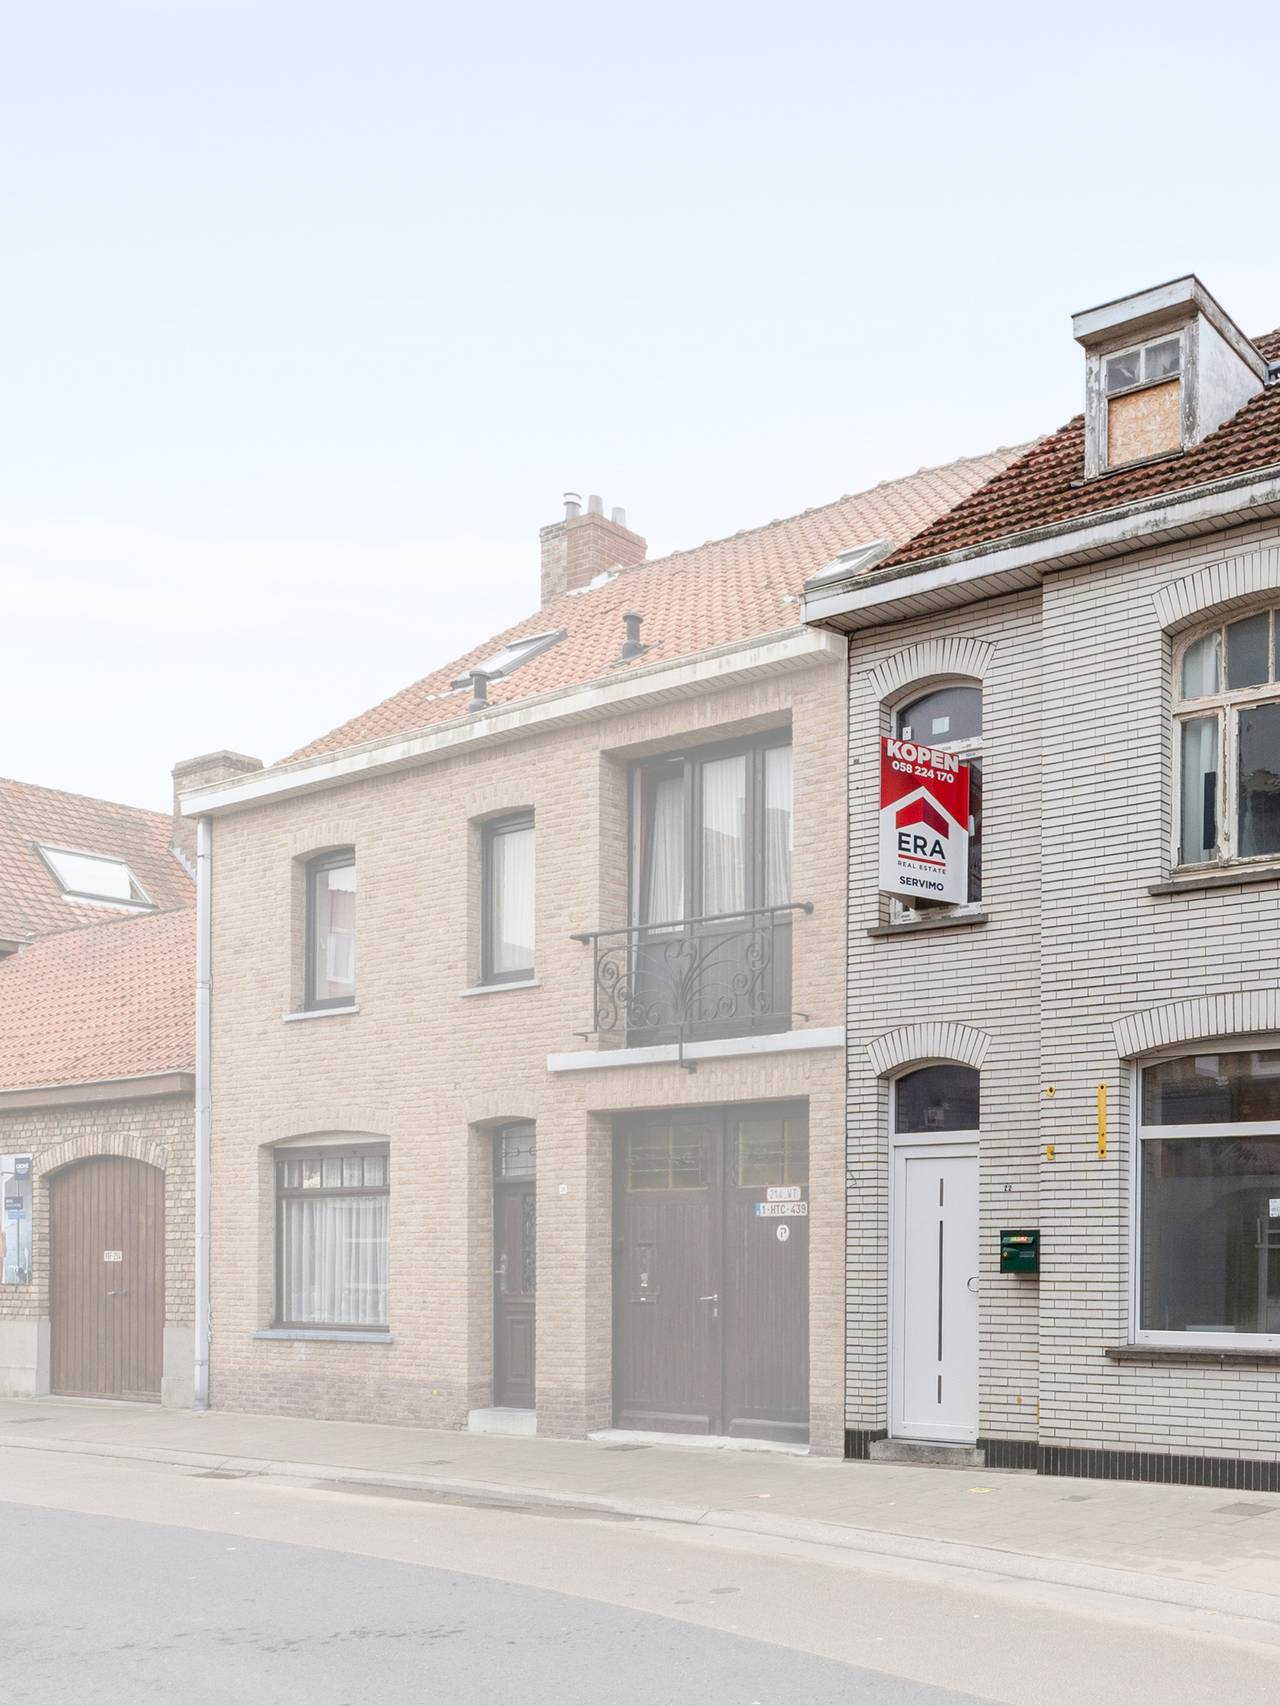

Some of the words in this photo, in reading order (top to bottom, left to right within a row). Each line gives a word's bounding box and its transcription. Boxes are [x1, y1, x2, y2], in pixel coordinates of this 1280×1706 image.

[887, 739, 959, 773] KOPEN
[892, 761, 913, 773] 058
[914, 767, 935, 779] 224
[936, 771, 954, 783] 170
[898, 832, 946, 860] ERA
[898, 861, 916, 870] REAL
[919, 864, 946, 875] ESTATE
[899, 876, 944, 891] SERVIMO
